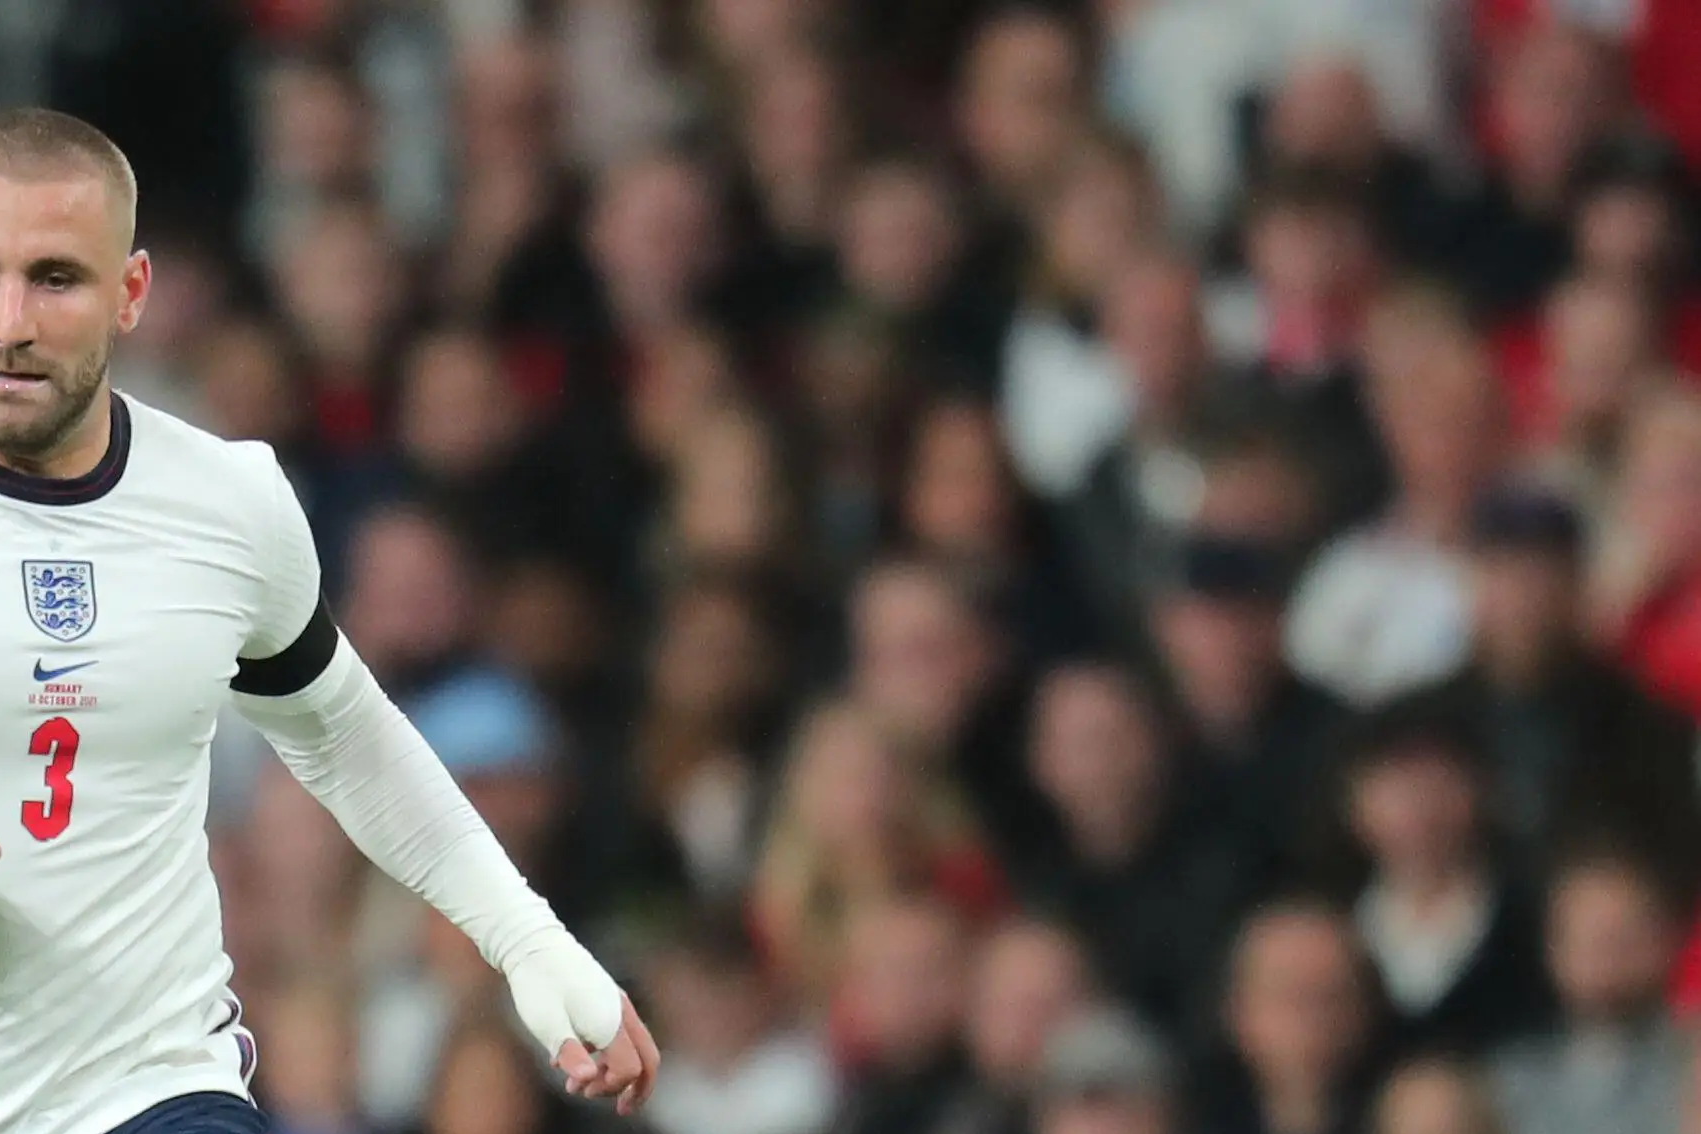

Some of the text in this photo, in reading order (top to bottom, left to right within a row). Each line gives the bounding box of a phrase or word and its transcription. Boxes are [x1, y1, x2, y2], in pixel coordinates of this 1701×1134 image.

[44, 684, 82, 693] HUNGARY
[39, 695, 76, 706] OCTOBER
[21, 716, 80, 841] 3
